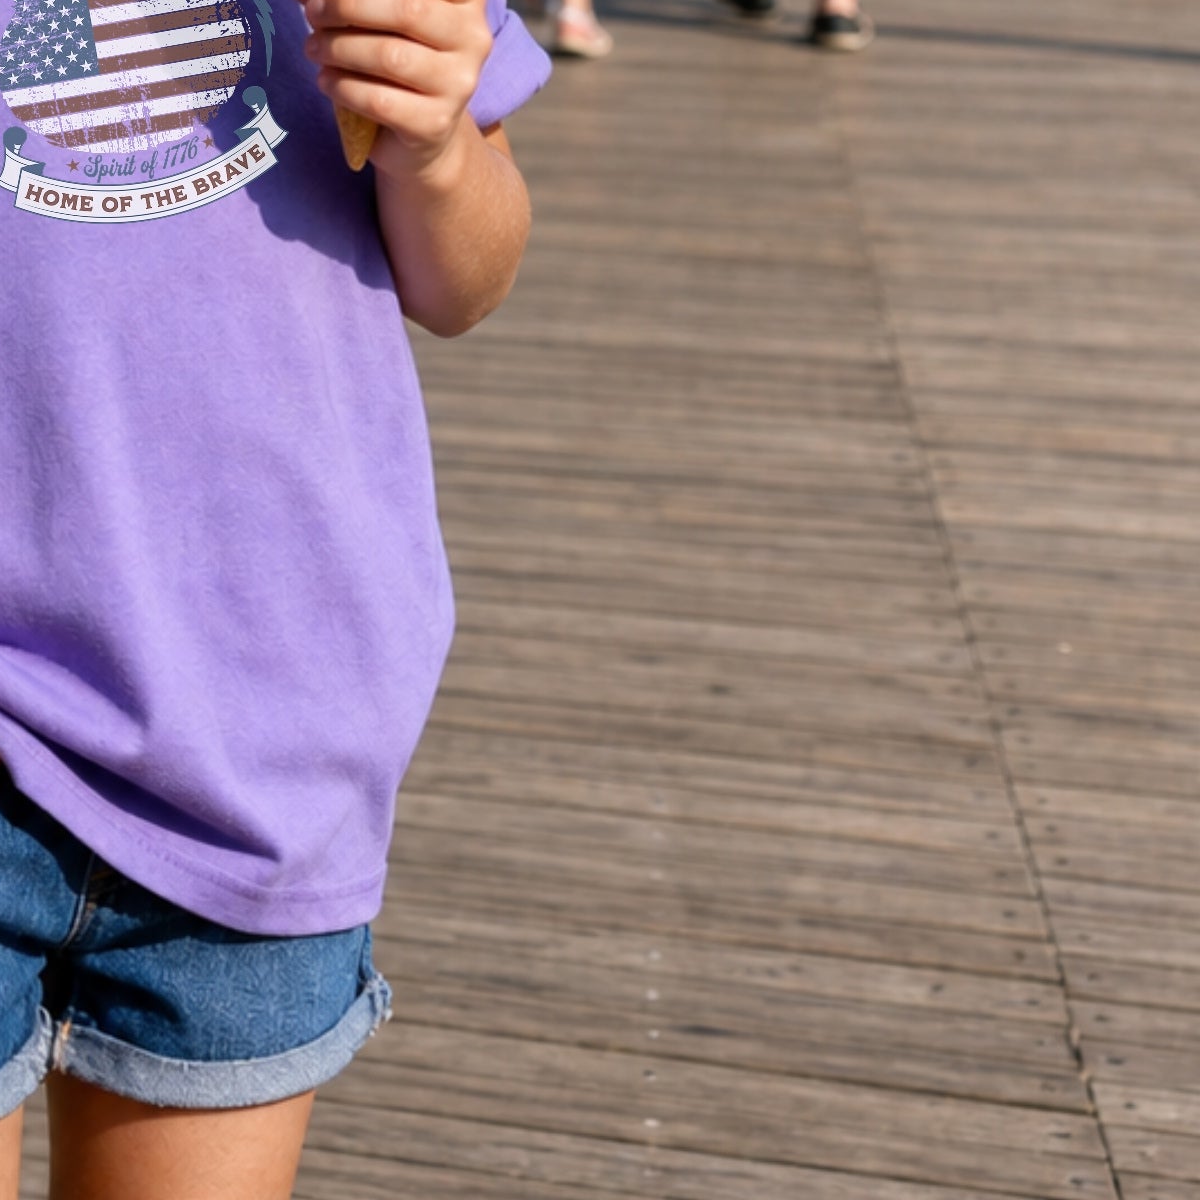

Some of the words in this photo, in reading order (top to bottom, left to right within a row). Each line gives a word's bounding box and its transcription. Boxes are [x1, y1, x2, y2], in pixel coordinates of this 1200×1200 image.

[24, 184, 94, 213] HOME
[101, 196, 133, 213] OF
[140, 185, 188, 210] THE
[191, 143, 266, 195] BRAVE
[83, 154, 136, 183] Spirit
[140, 151, 158, 179] of
[162, 135, 199, 170] 1776
